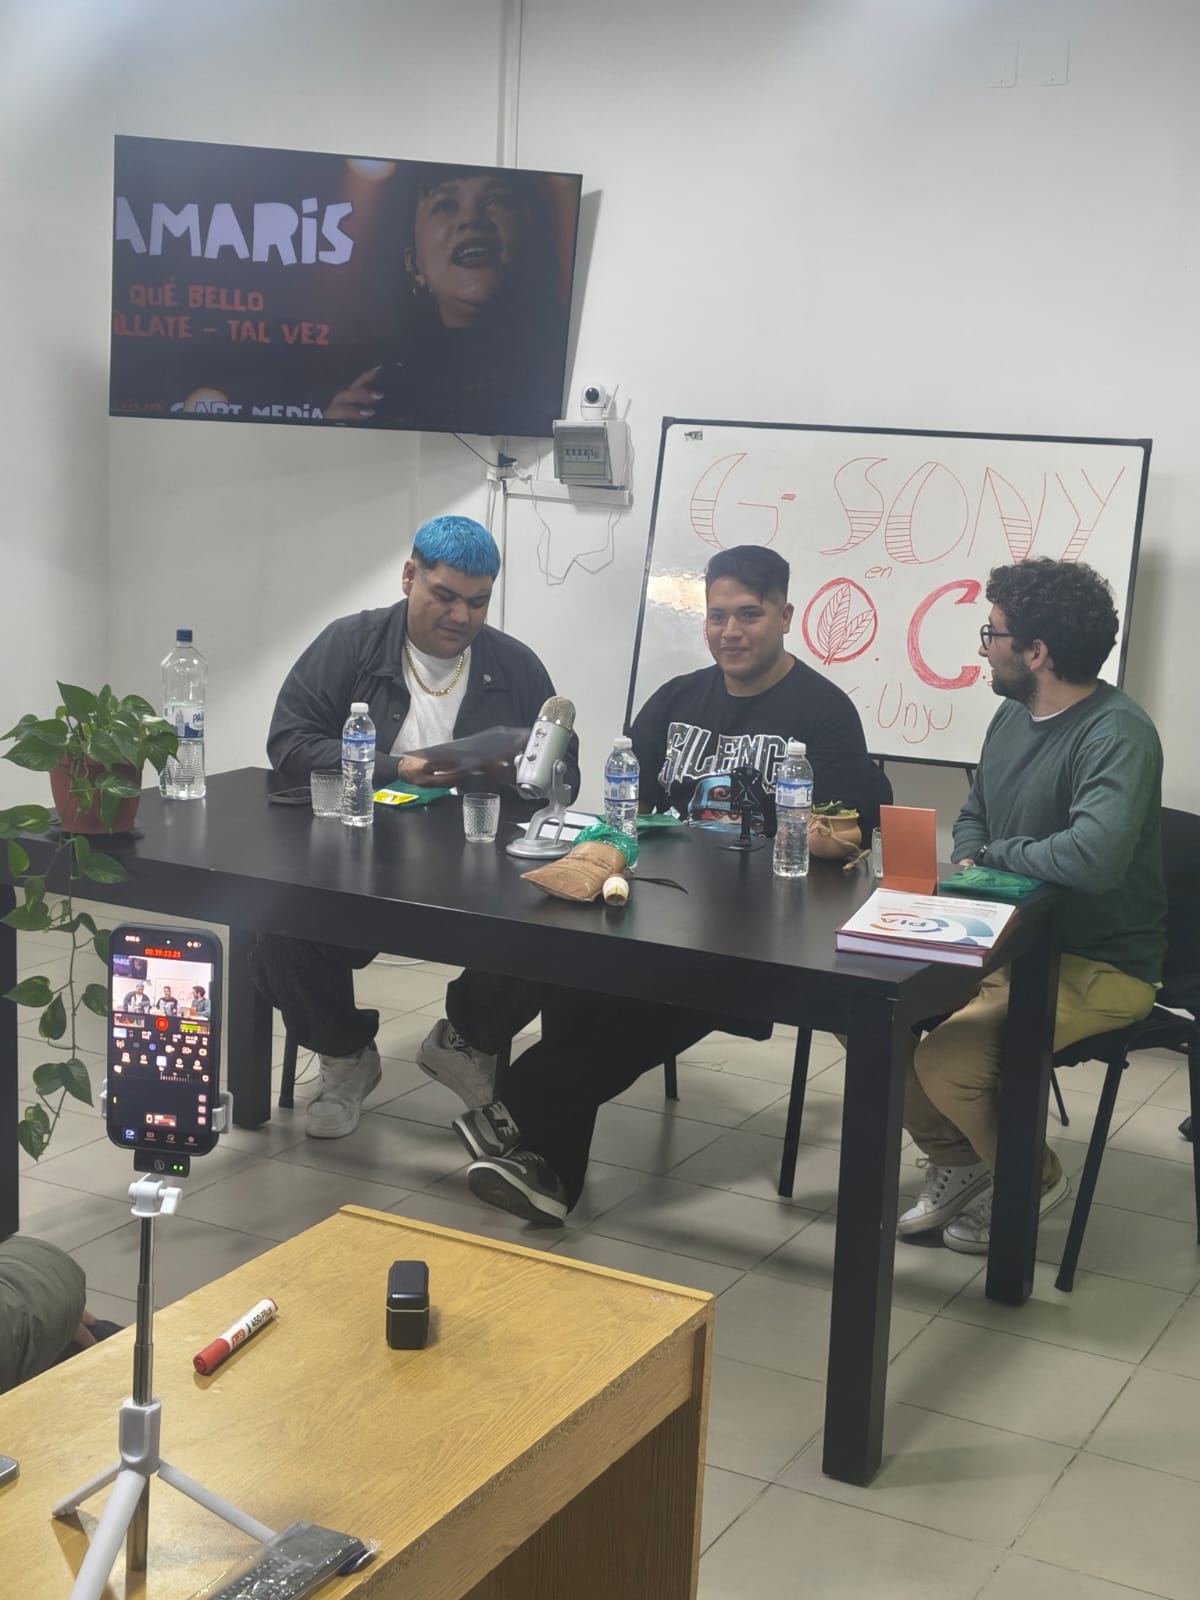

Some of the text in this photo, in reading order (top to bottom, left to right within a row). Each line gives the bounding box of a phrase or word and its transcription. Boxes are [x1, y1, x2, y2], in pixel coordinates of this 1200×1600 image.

[188, 284, 264, 312] BELLO
[228, 319, 271, 344] TAL
[281, 321, 330, 346] VEZ
[864, 566, 893, 579] en
[657, 721, 794, 796] SILENC
